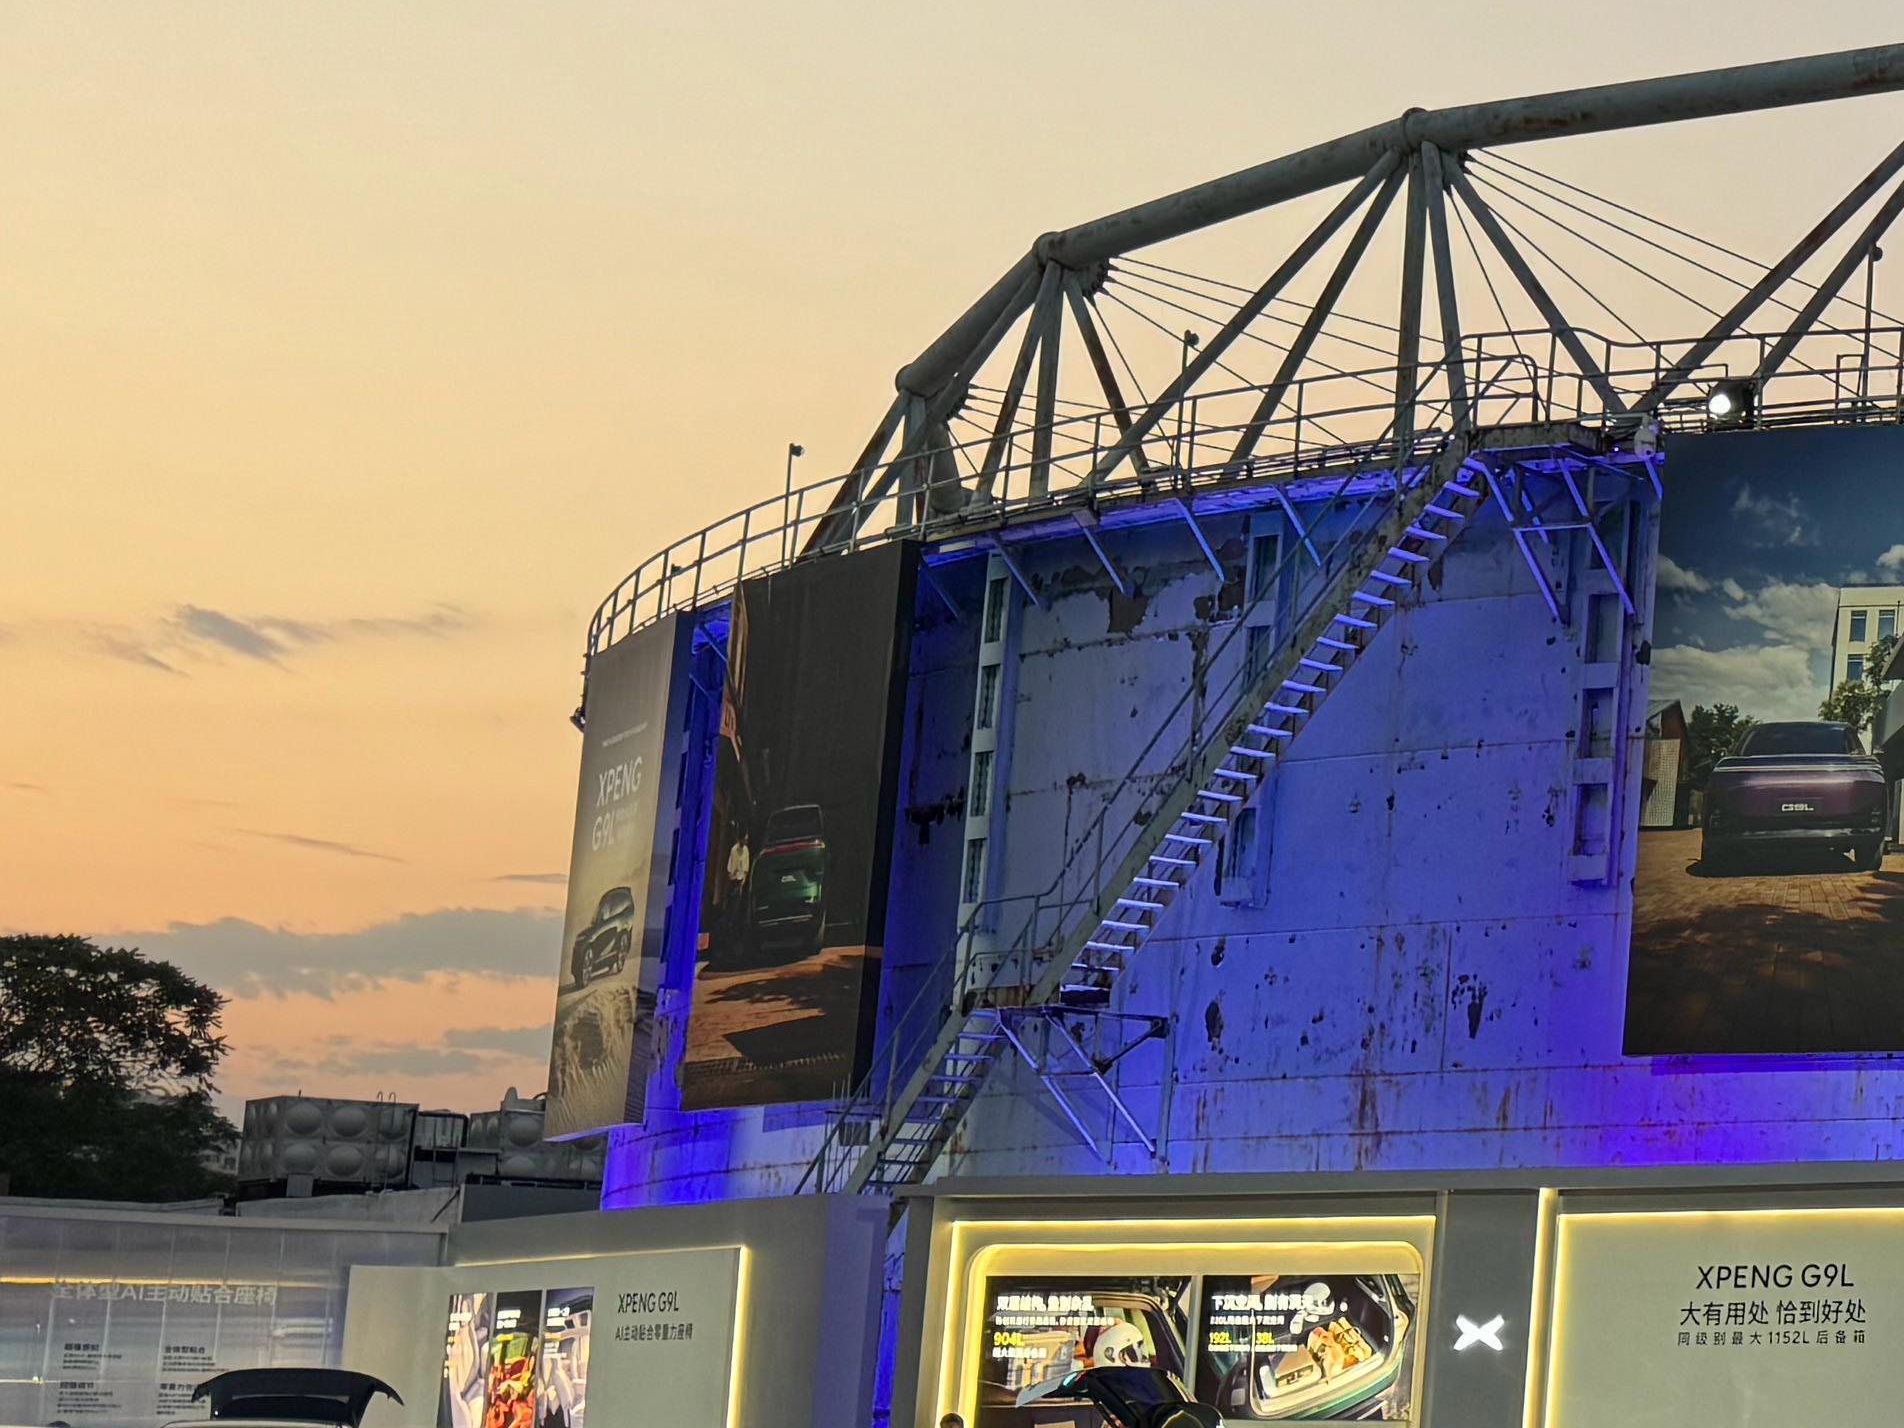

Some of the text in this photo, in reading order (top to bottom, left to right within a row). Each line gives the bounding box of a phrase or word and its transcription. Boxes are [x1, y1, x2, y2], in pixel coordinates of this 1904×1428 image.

[597, 756, 642, 807] XPENG
[592, 812, 614, 851] G9L
[1696, 1262, 1855, 1290] XPENG G9L
[617, 1289, 680, 1315] XPENG G9L
[1680, 1298, 1866, 1327] 大有用处 恰到好处
